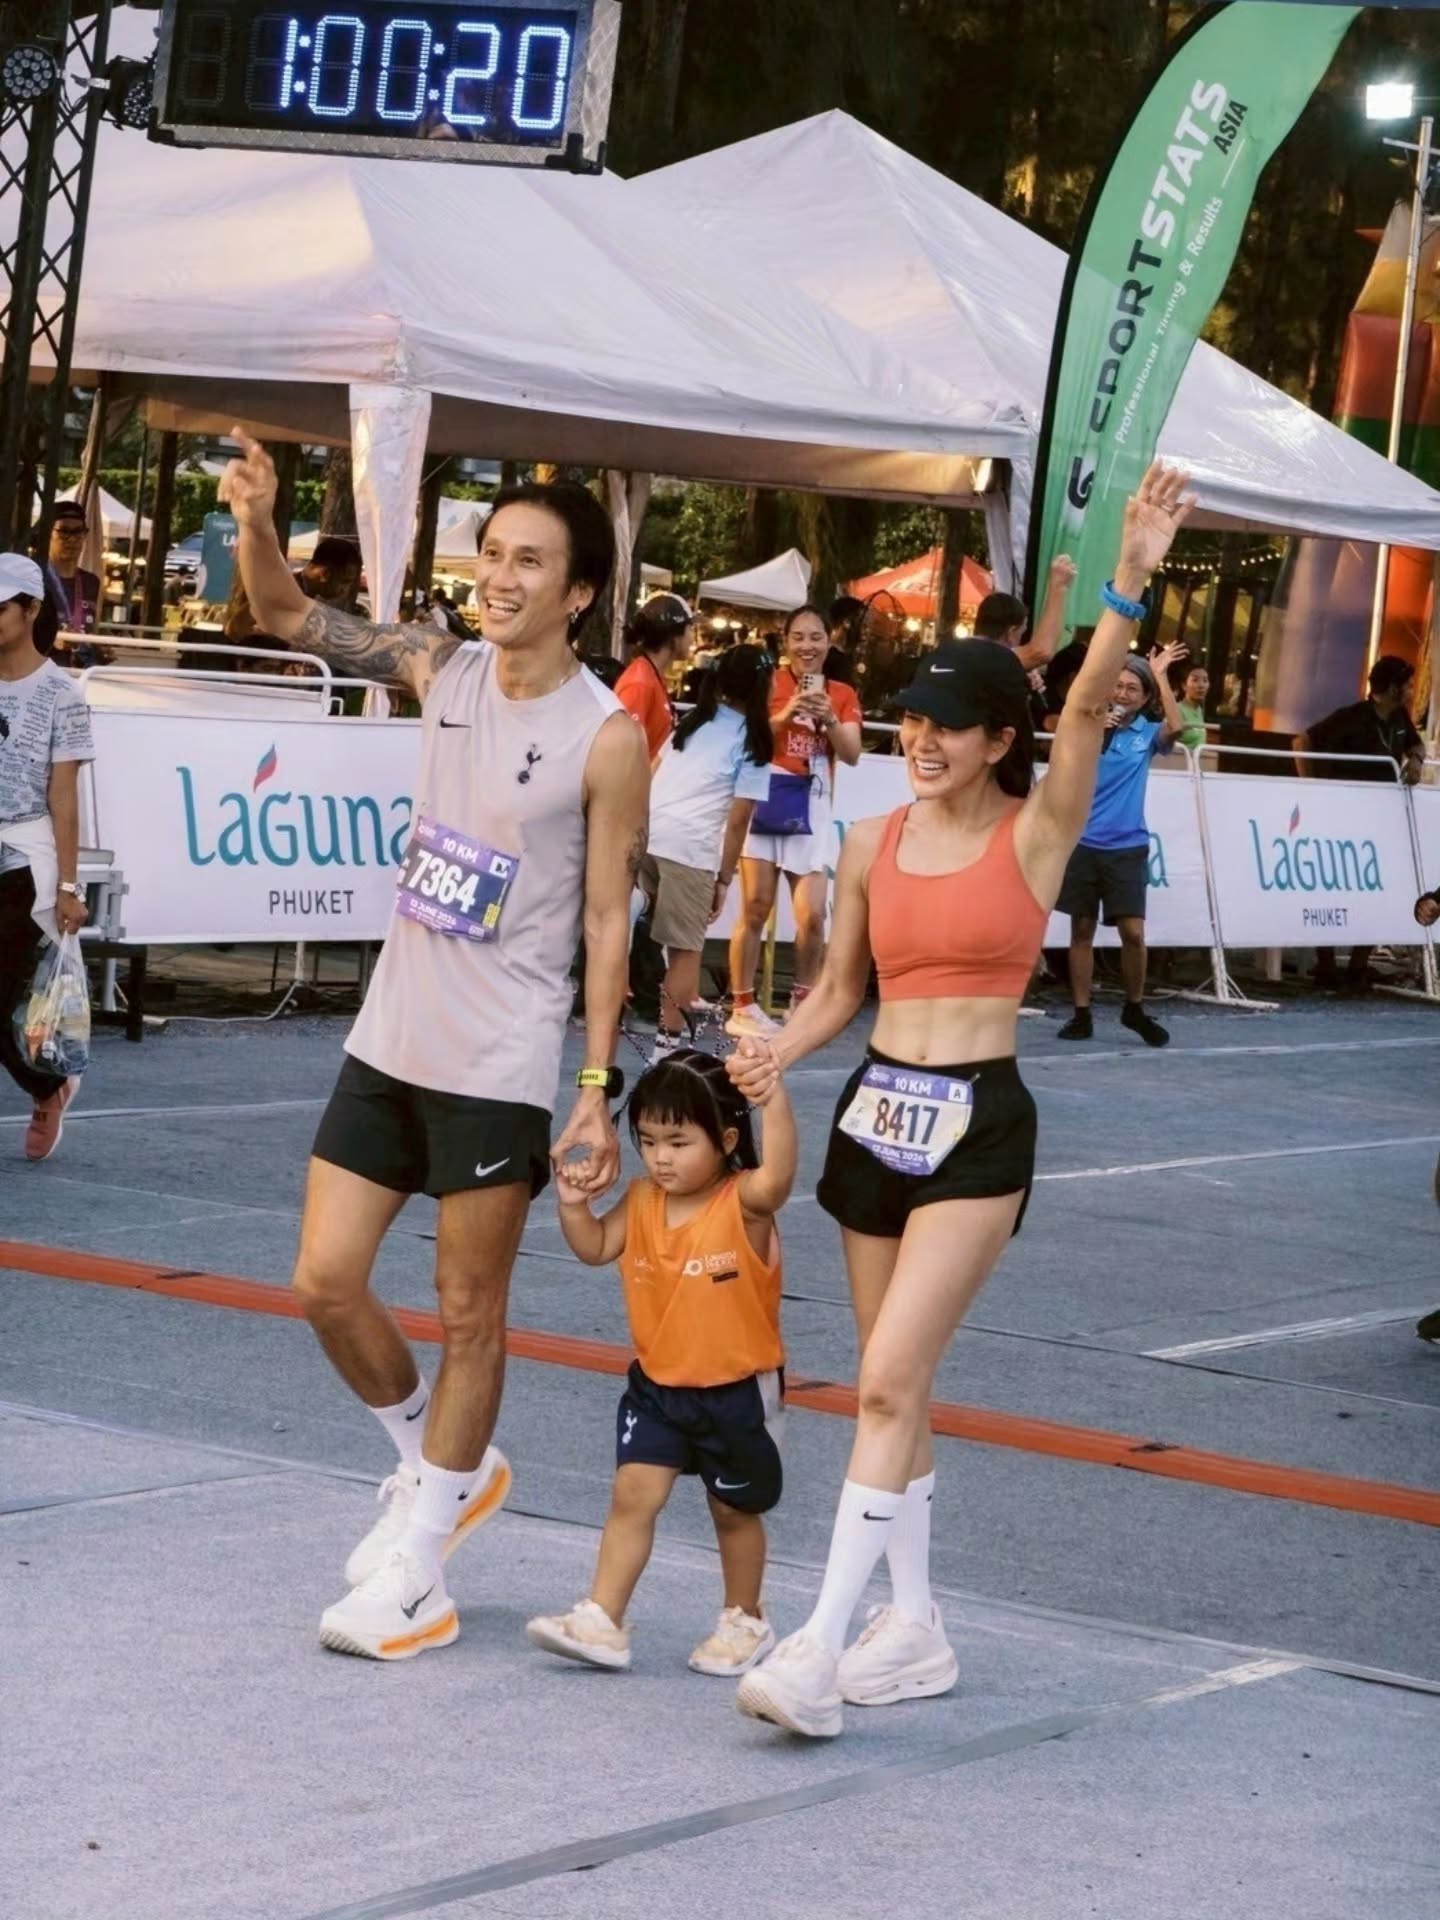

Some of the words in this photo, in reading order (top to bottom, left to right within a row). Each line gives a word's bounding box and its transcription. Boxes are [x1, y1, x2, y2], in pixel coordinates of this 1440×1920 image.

[280, 15, 571, 129] 1:00:20
[1213, 100, 1248, 155] ASIA
[1115, 342, 1160, 444] Professional
[1178, 259, 1194, 276] &
[1186, 196, 1224, 257] Results
[442, 837, 457, 853] 10
[456, 843, 479, 863] KM
[407, 848, 480, 914] 7364
[269, 890, 354, 915] PHUKET
[1303, 907, 1349, 927] PHUKET
[895, 1076, 907, 1092] 10
[908, 1079, 932, 1096] KM
[953, 1088, 961, 1099] A
[872, 1097, 940, 1145] 8417
